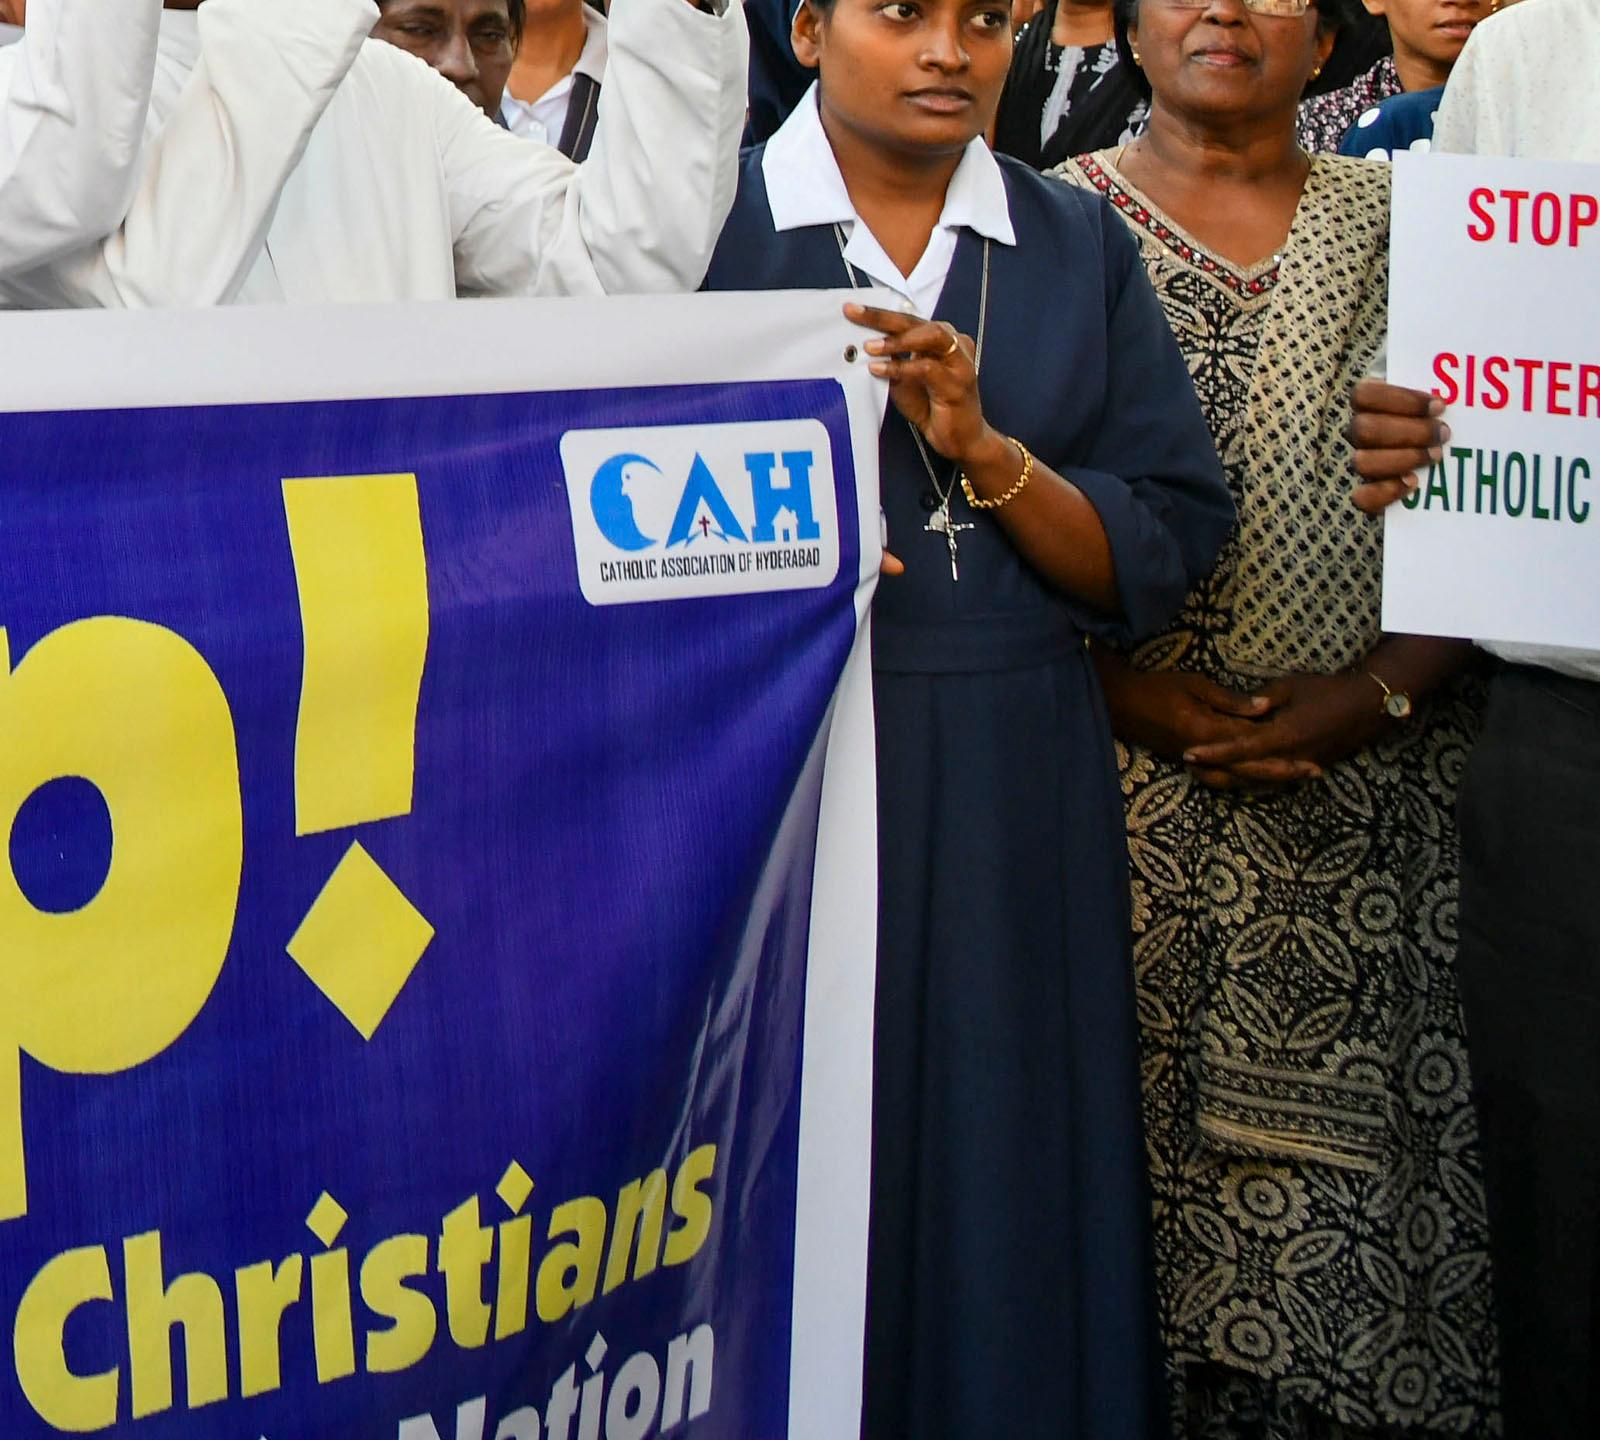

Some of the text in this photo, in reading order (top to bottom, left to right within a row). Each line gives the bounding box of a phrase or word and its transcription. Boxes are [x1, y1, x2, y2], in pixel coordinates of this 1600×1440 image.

[1466, 186, 1598, 249] STOP
[590, 450, 821, 552] CAH
[1400, 446, 1592, 525] ATHOLIC
[600, 547, 821, 583] CATHOLIC ASSOCIATION OF HYDERABAD
[12, 1142, 717, 1433] Christians
